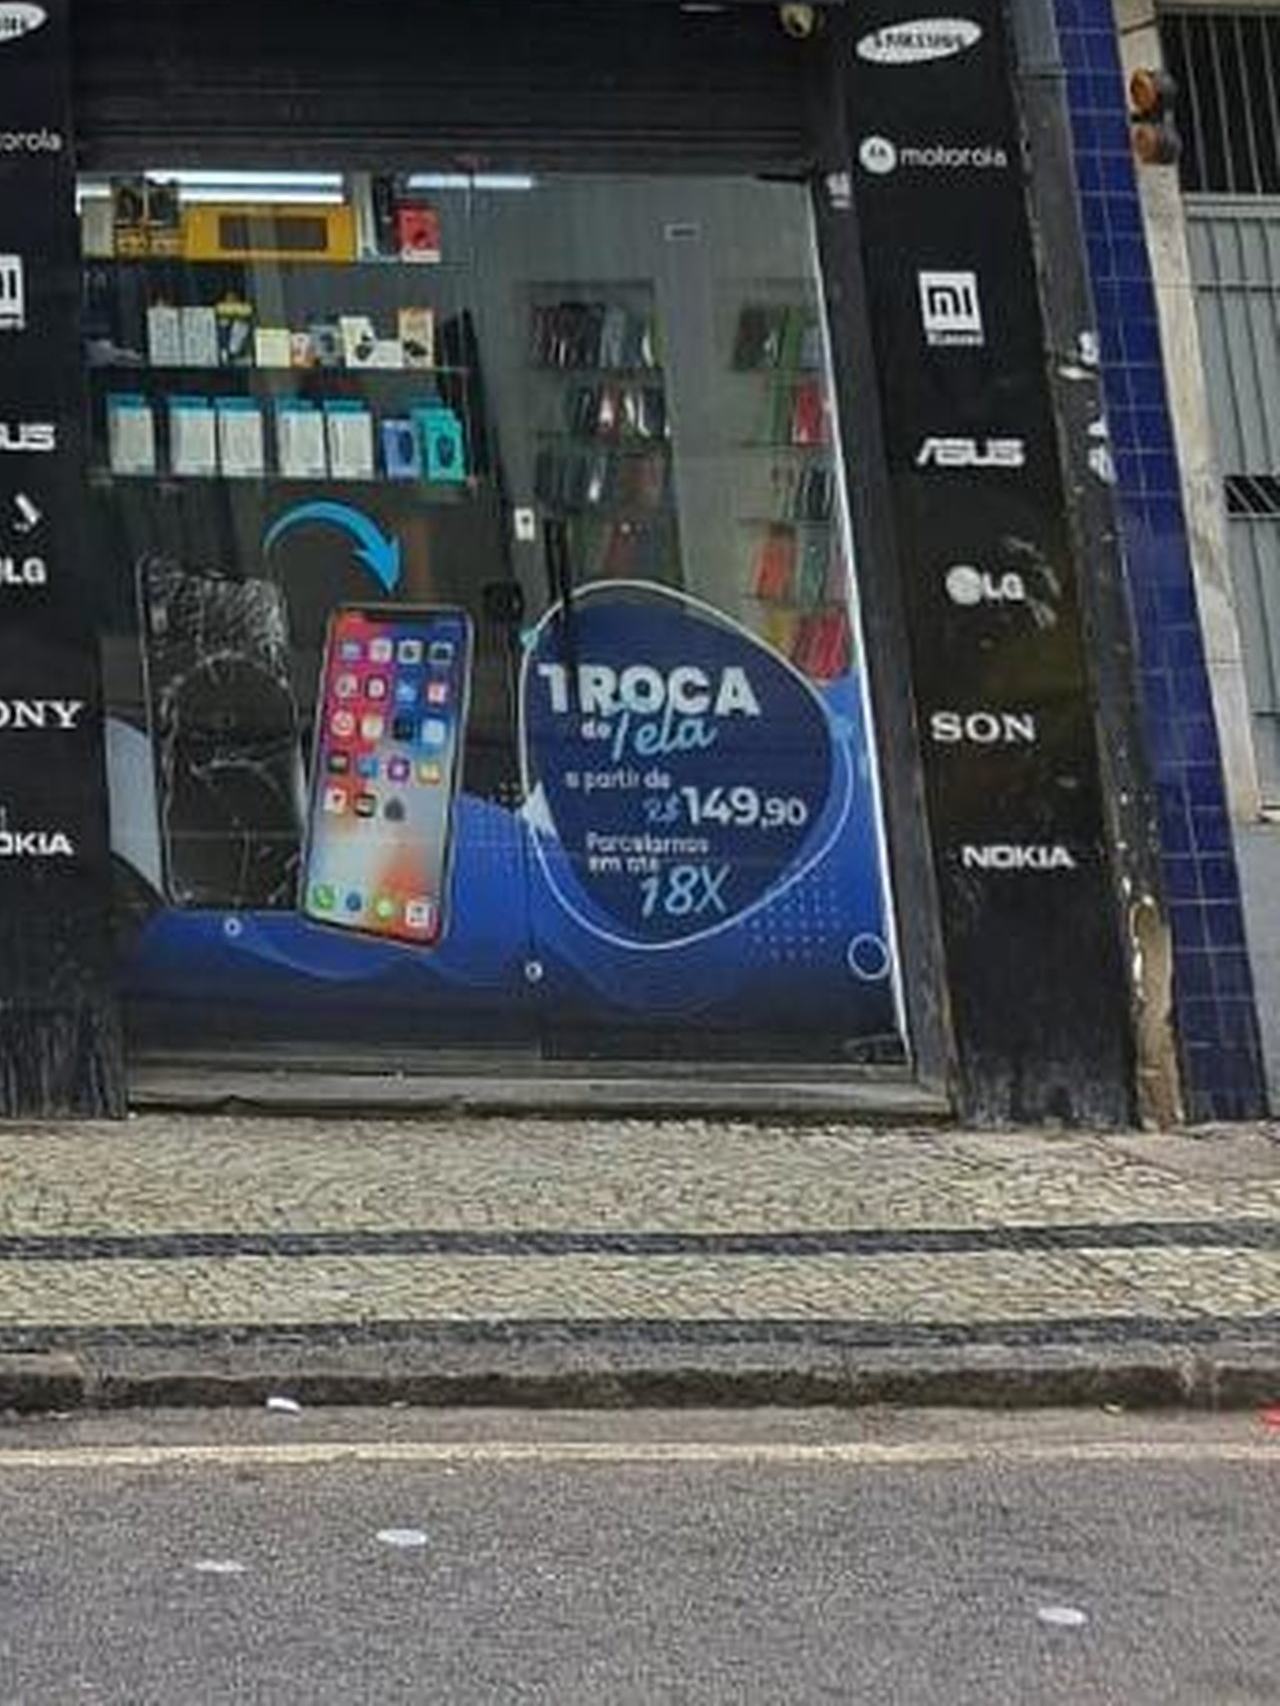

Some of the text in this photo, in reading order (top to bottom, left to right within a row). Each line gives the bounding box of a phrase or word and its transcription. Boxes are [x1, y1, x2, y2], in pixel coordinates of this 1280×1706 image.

[899, 146, 1008, 169] motorola
[916, 438, 1026, 467] ASUS
[4, 557, 47, 585] LG
[981, 571, 1026, 601] LG
[539, 661, 762, 718] TROCA
[682, 786, 807, 828] 149,90
[962, 845, 1078, 869] NOKIA
[641, 863, 730, 919] 18X
